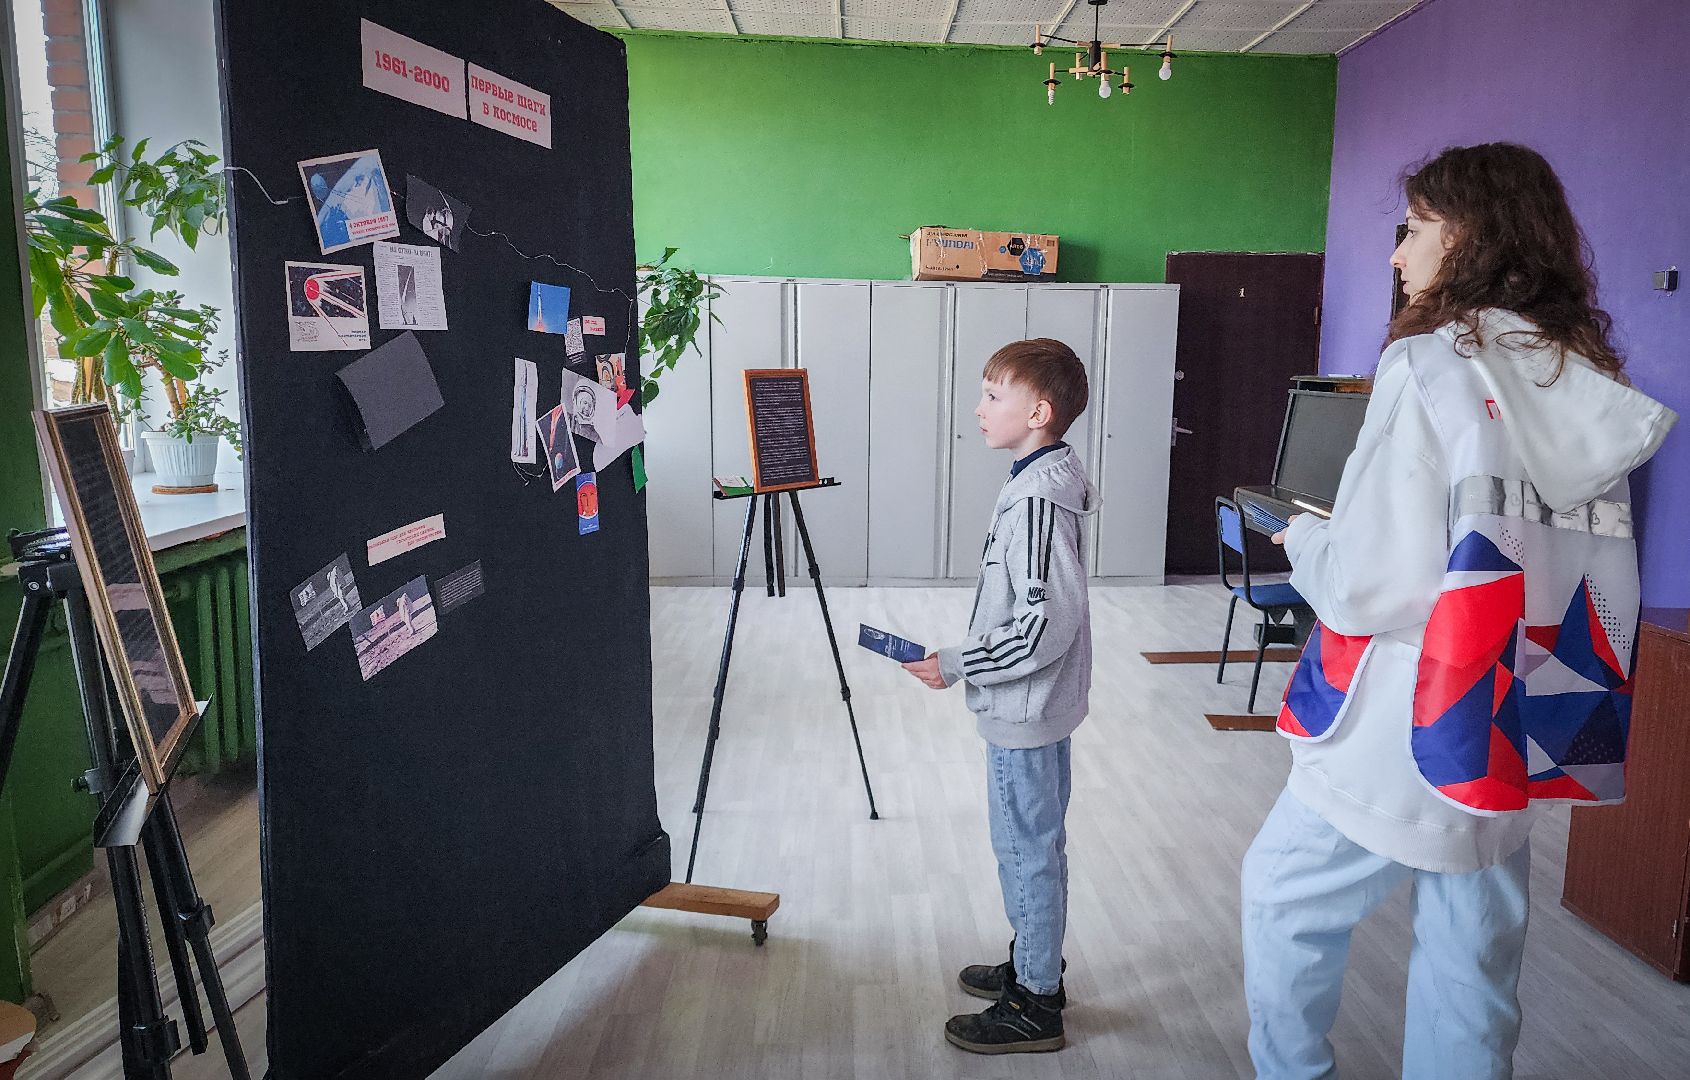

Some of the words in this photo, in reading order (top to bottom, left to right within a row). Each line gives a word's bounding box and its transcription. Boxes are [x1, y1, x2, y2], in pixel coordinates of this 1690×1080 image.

[375, 51, 450, 93] 1961-2000
[493, 105, 537, 131] космосе
[517, 94, 546, 116] шаги
